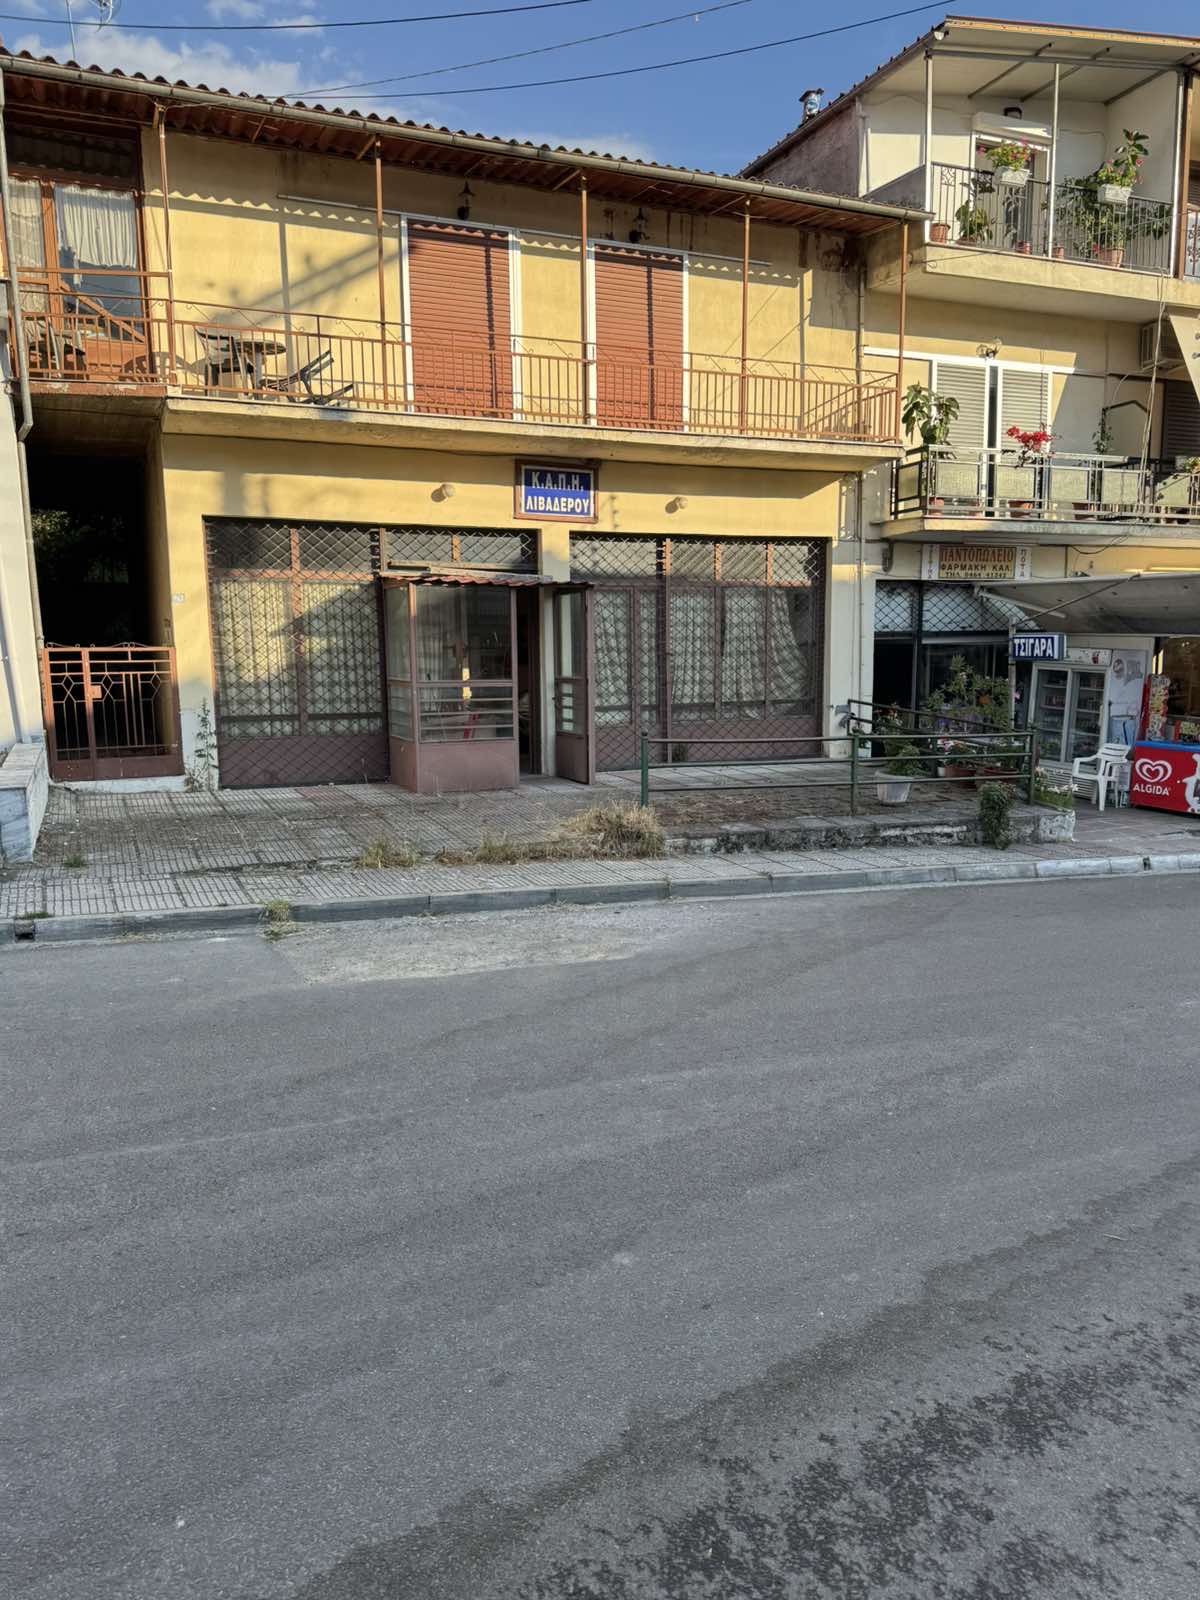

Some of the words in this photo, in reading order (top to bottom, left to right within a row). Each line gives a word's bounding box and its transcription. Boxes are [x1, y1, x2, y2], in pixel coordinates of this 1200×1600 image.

[531, 471, 584, 492] Κ.Α.Π.Η.
[525, 495, 590, 513] ΛΙΒΑΔΕΡΟΥ
[941, 548, 1014, 562] ΠΑΝΤΟΠΩΛΕΙΟ
[1013, 638, 1053, 657] ΤΣΙΓΑΡΑ
[1132, 783, 1169, 796] ALGIDA
